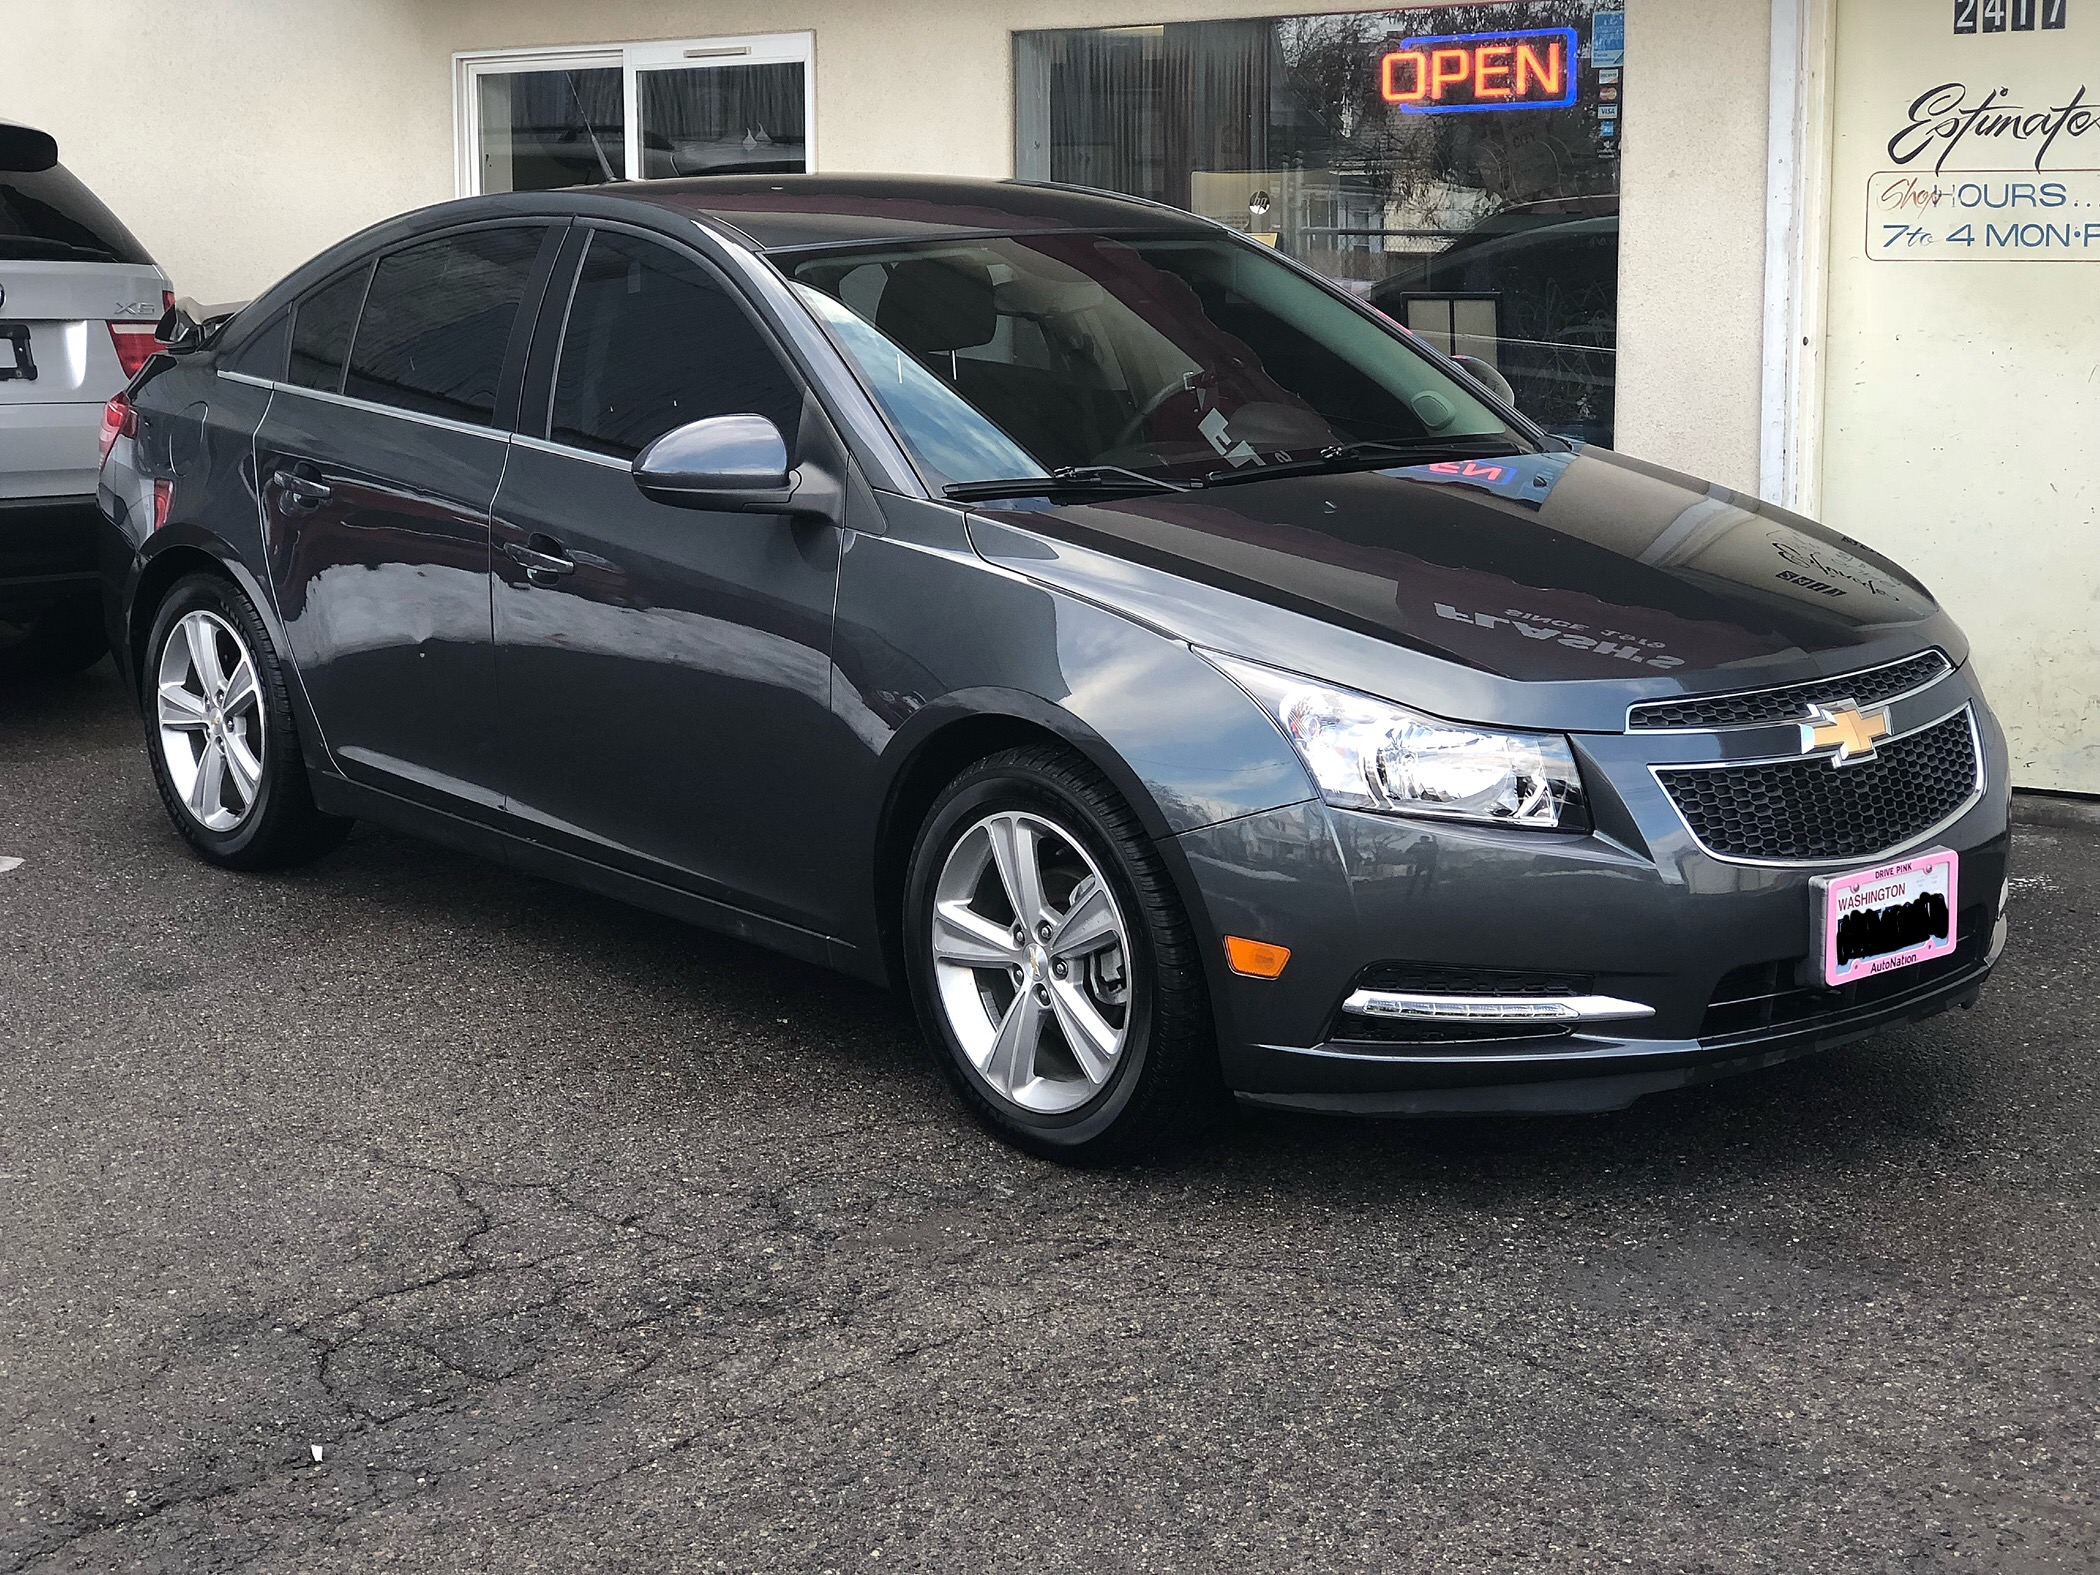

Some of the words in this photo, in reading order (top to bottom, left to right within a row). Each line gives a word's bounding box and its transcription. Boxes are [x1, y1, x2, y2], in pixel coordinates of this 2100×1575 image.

[1955, 0, 2063, 28] 2417
[1381, 43, 1560, 102] OPEN
[1888, 83, 2100, 177] Estimate
[1878, 177, 1942, 219] Shop
[1883, 225, 1909, 247] 7
[1906, 227, 1938, 247] to
[1946, 224, 1975, 247] 4
[114, 302, 155, 315] X5
[1875, 868, 1894, 879] DRIVE
[1896, 863, 1912, 874] PINK
[1838, 883, 1906, 911] WASHINGTON
[1870, 954, 1917, 973] AutoNation
